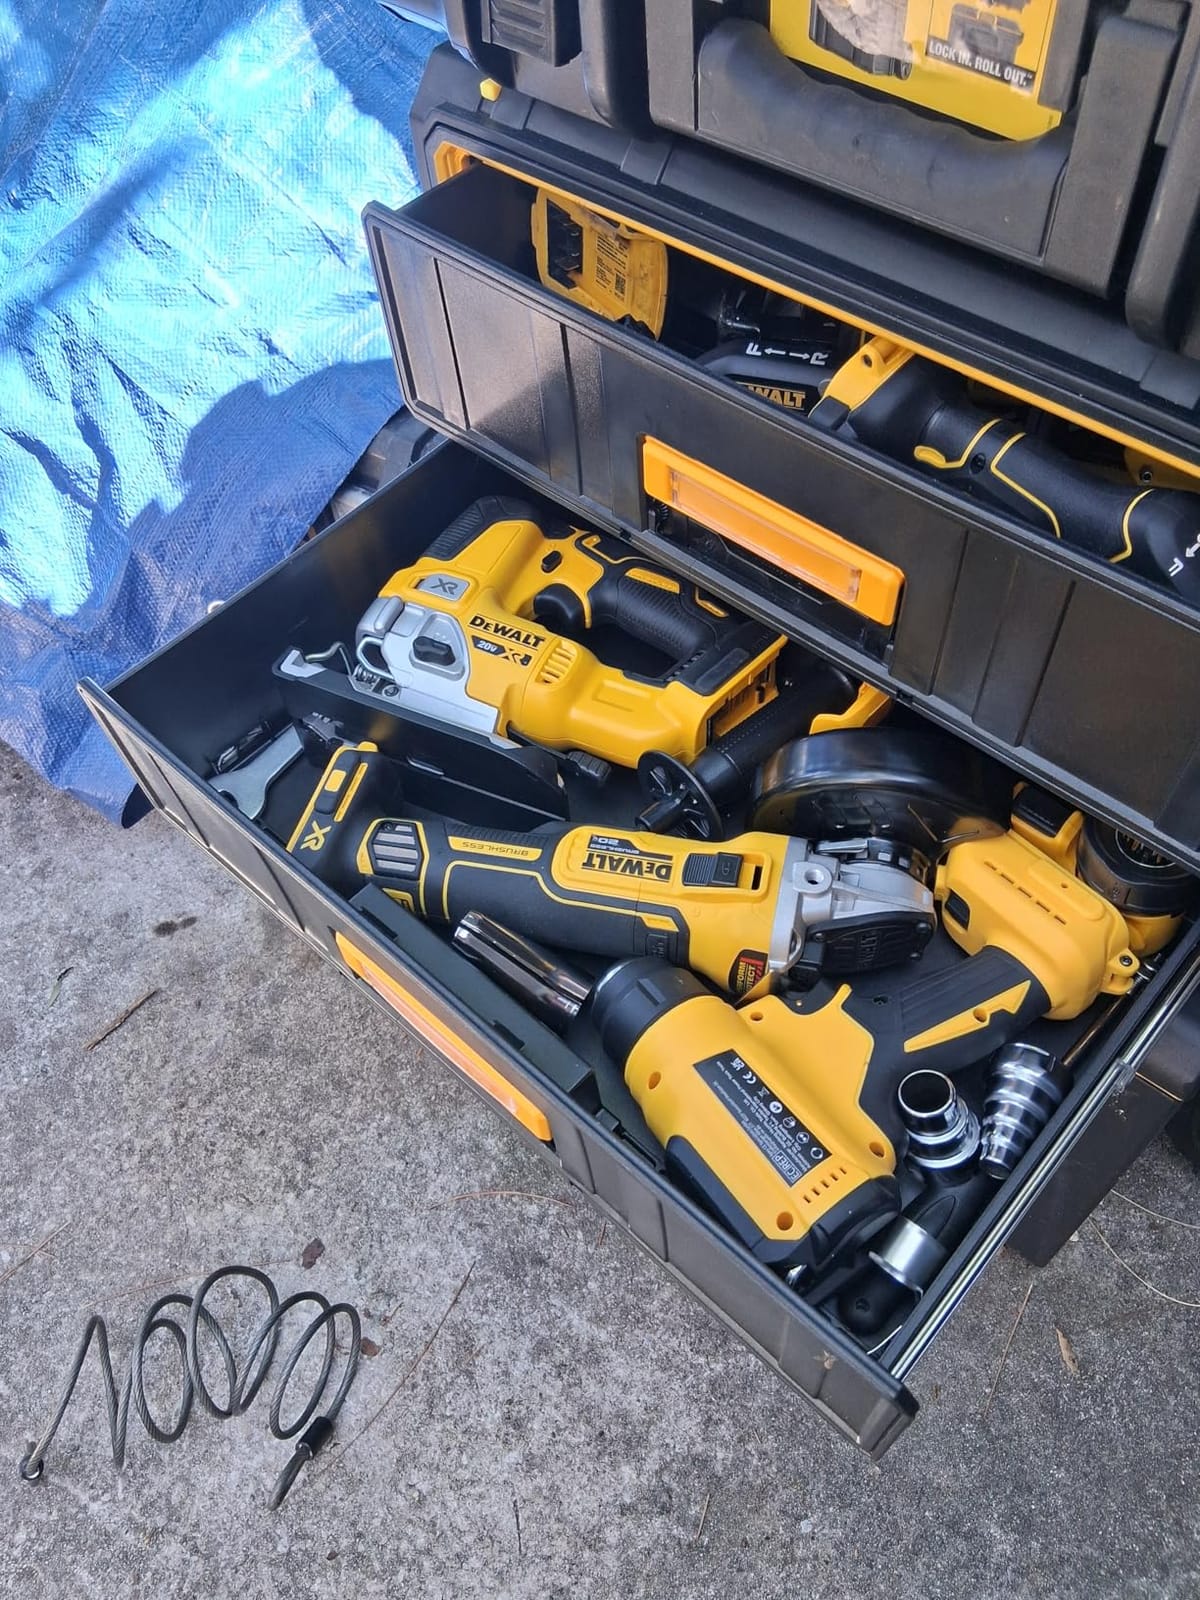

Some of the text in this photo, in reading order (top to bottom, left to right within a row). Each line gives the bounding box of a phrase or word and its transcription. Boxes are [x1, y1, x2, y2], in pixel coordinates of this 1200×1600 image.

[928, 39, 957, 60] LOCK
[957, 50, 973, 67] IN.
[974, 56, 1002, 78] ROLL
[745, 342, 829, 366] F R
[1168, 557, 1184, 577] F
[430, 577, 459, 596] XR
[469, 614, 546, 648] DEWALT
[476, 640, 499, 653] 20V
[300, 820, 332, 851] XR
[462, 841, 529, 857] BRUSHLESS
[581, 852, 673, 881] DEWALT
[773, 1151, 800, 1180] EC REP
